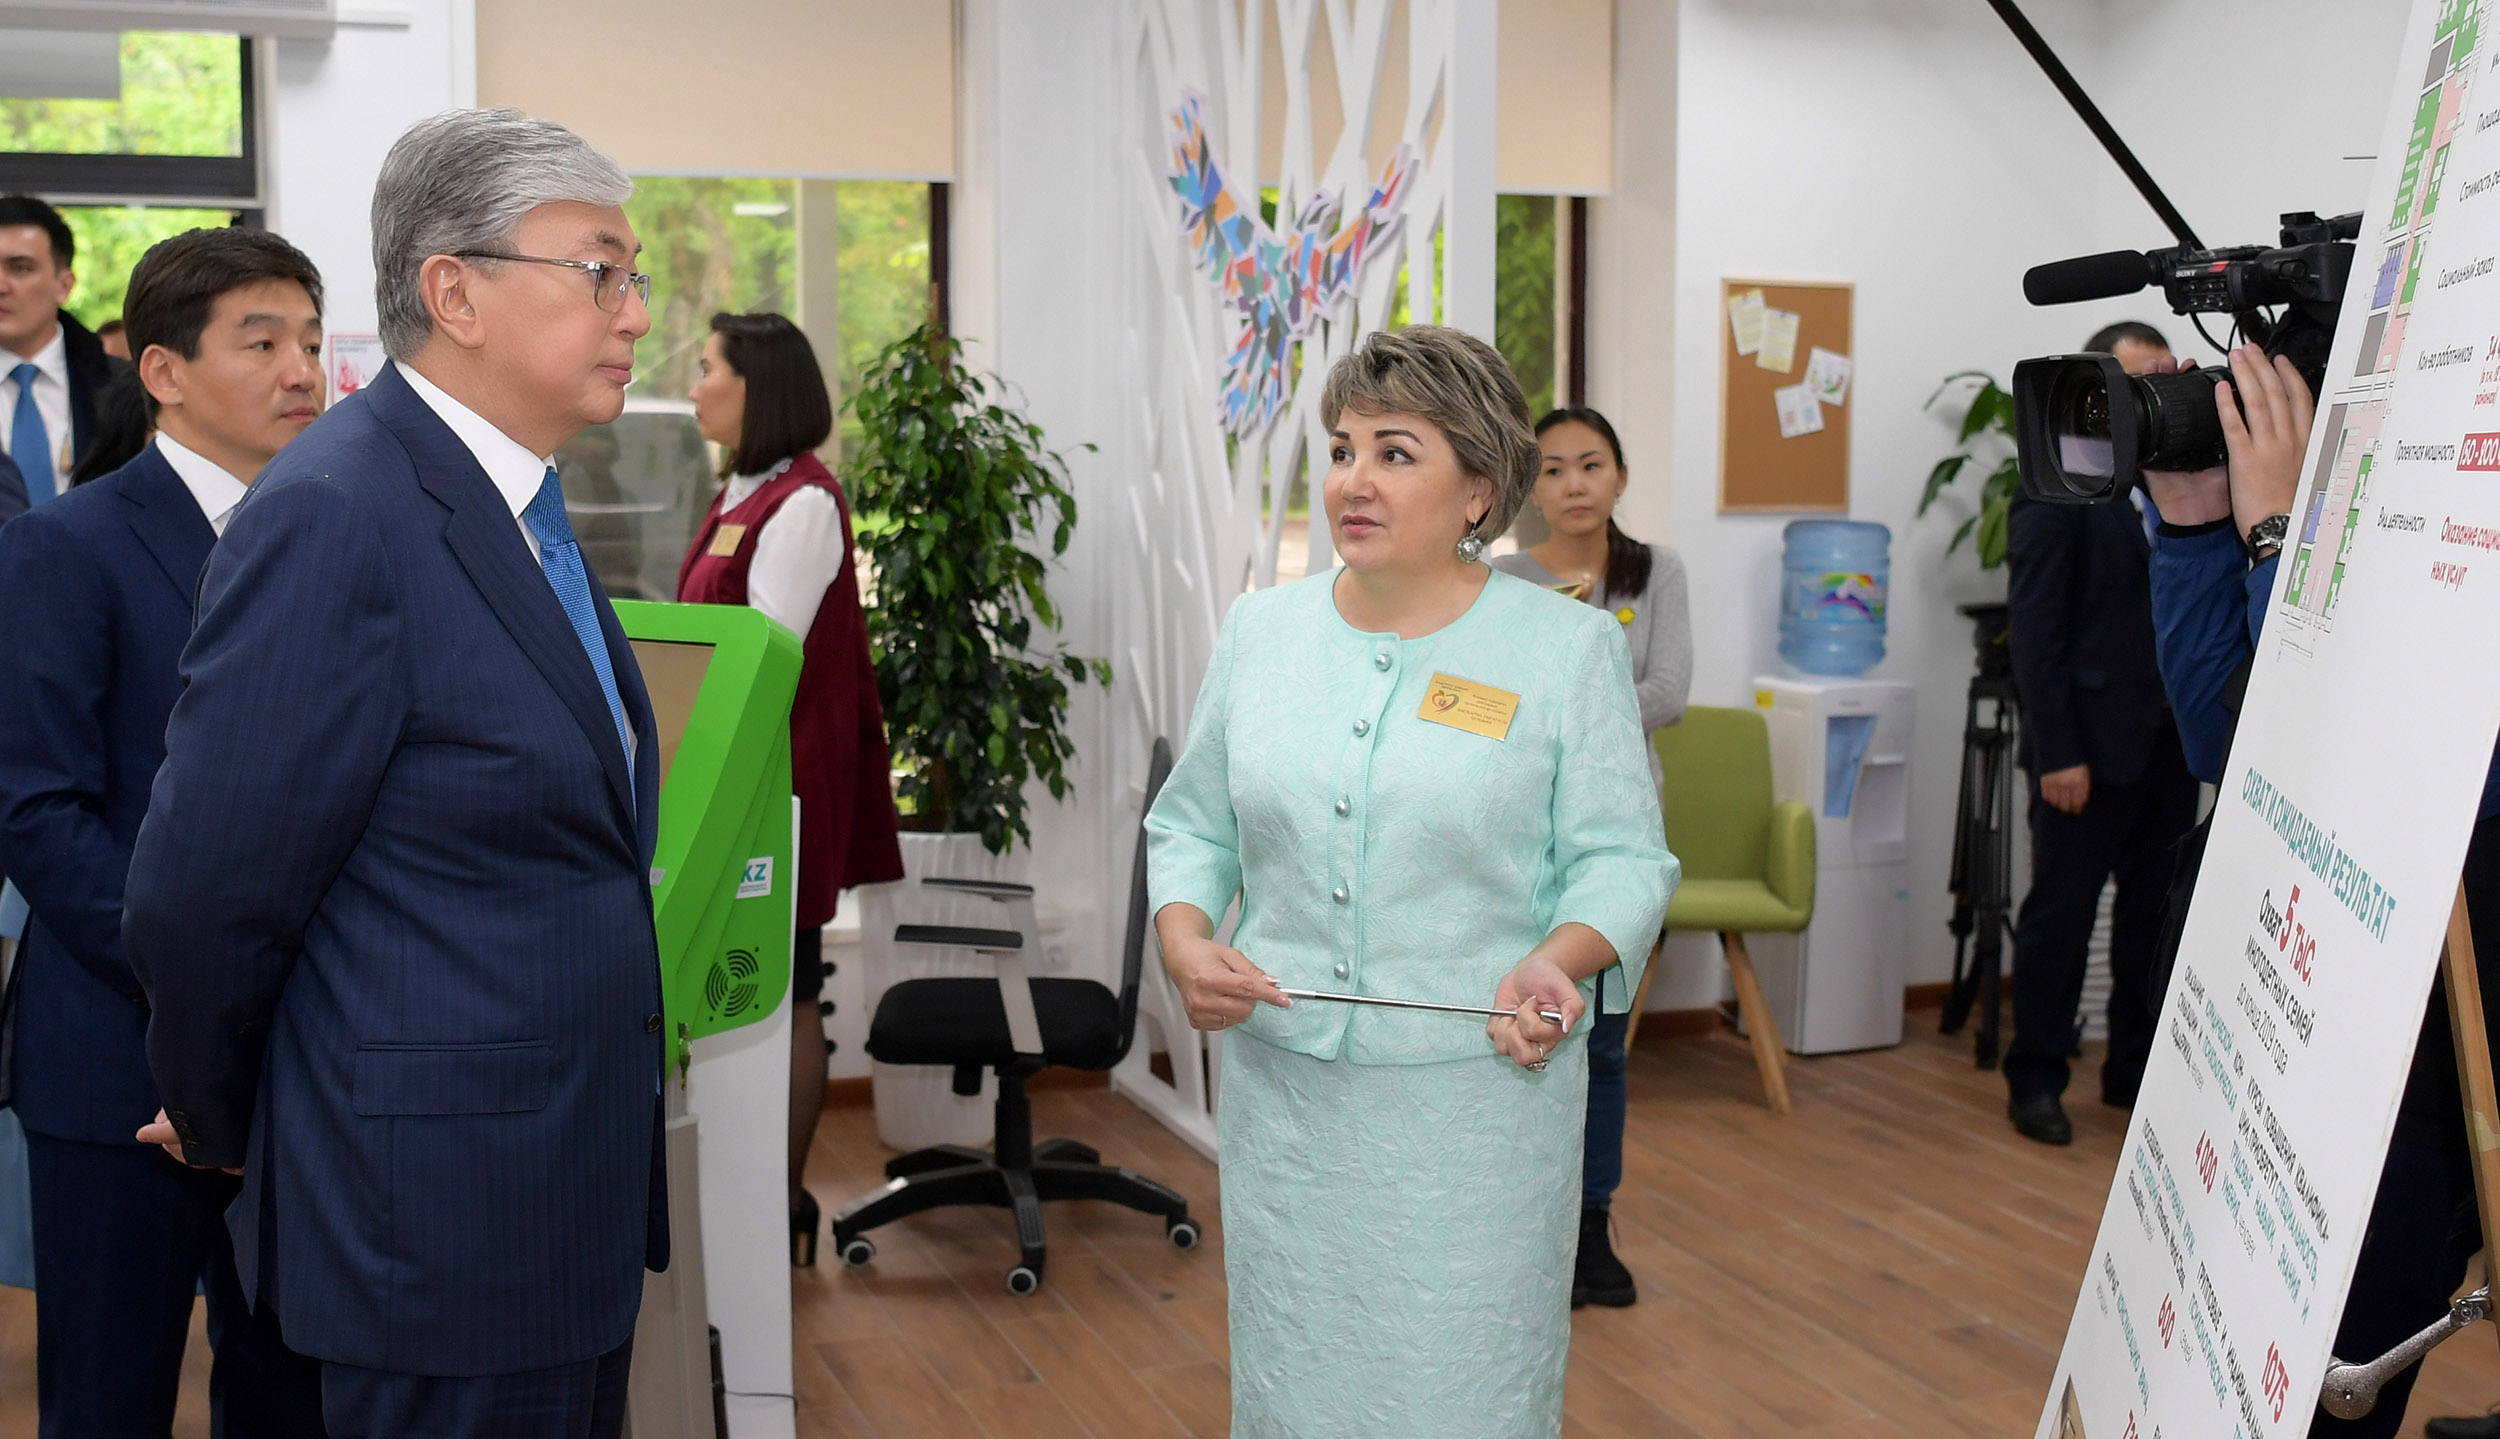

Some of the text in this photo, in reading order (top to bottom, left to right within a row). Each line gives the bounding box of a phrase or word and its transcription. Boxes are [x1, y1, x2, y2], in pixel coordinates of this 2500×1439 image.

[2176, 270, 2196, 279] SONY
[2441, 516, 2478, 547] Оказание
[2242, 767, 2397, 944] ОХВАТ И ОЖИДАЕМЫЙ РЕЗУЛЬТАТ
[2259, 883, 2316, 988] Охват 5 тыс.
[2244, 934, 2316, 1048] многодетных семей
[2258, 1010, 2276, 1052] 2019
[2270, 1038, 2288, 1076] года
[2246, 1074, 2265, 1118] КУРСЫ
[2262, 1105, 2297, 1176] ПОВЫШЕНИЯ
[2158, 1292, 2176, 1349] 600
[2261, 1340, 2290, 1424] 1075
